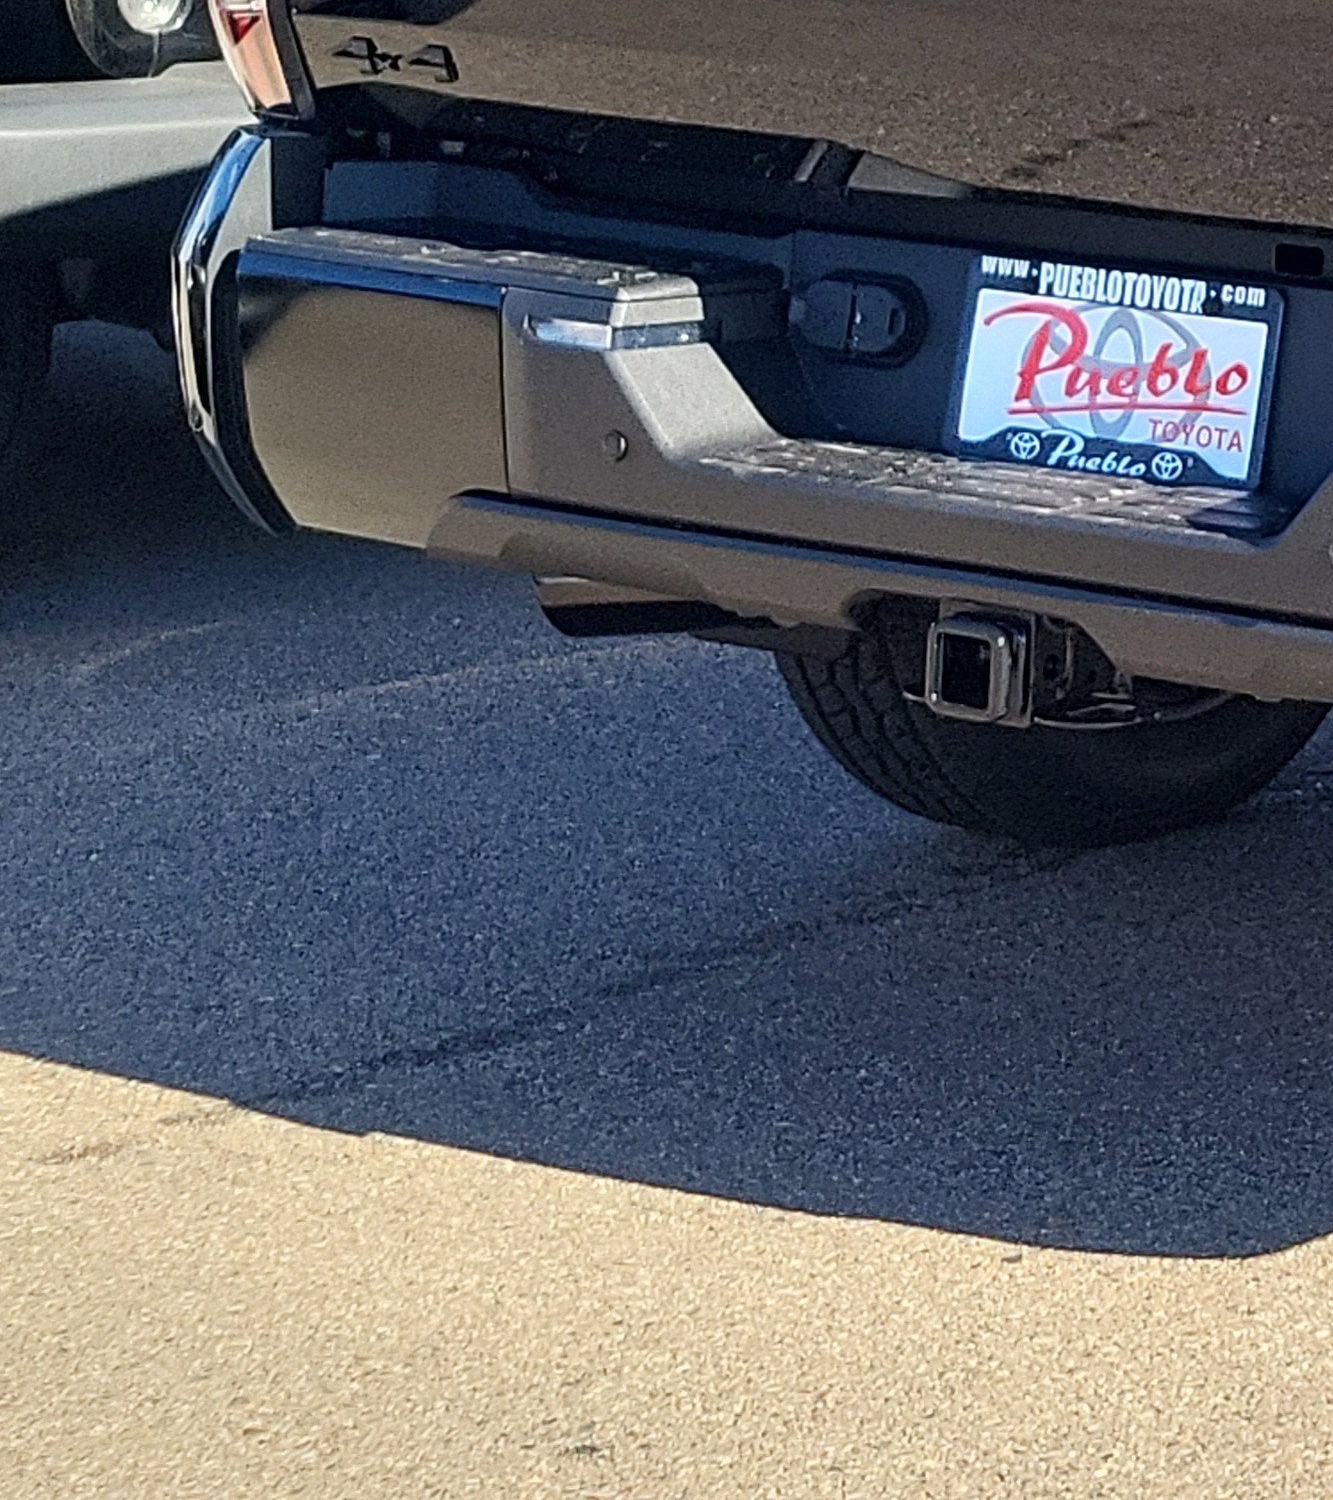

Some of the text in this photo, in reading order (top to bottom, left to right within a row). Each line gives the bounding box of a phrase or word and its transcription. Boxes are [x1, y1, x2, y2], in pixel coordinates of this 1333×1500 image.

[983, 301, 1249, 403] Pueblo
[1041, 429, 1149, 479] Pueblo
[1148, 418, 1243, 453] TOYOTA
